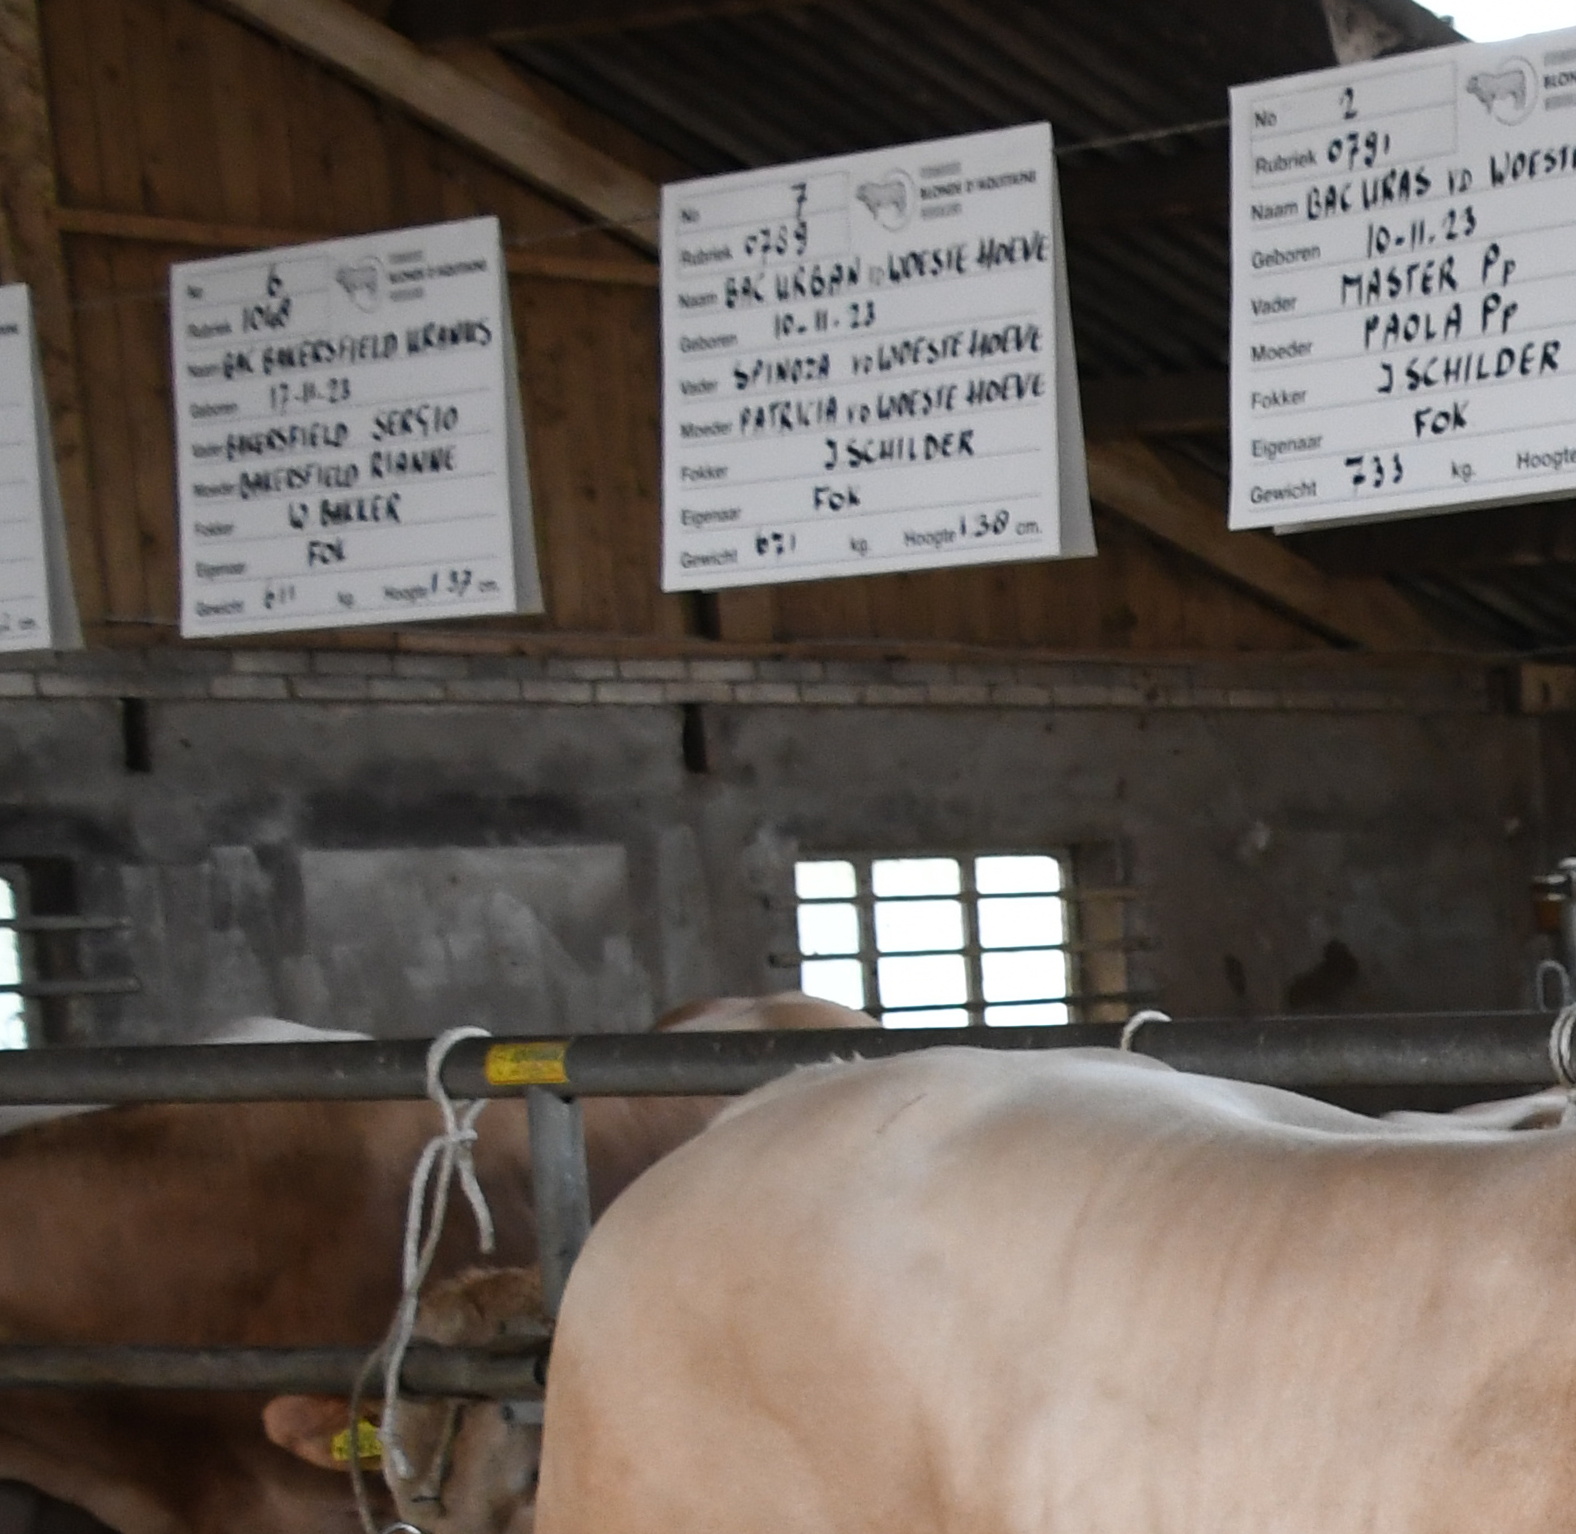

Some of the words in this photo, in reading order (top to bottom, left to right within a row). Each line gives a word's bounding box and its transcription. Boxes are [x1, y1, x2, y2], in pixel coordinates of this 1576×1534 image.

[1254, 110, 1277, 128] No
[1339, 86, 1358, 120] 2
[1254, 149, 1317, 175] Rubriek
[1251, 201, 1299, 220] Naam
[1306, 182, 1353, 221] BAC
[1362, 165, 1432, 211] URAS
[1252, 245, 1322, 269] Geboren
[1251, 296, 1298, 317] Vader
[1340, 255, 1459, 307] MASTER
[680, 331, 738, 353] Geboren
[1250, 339, 1314, 363] Moeder
[1364, 301, 1463, 351] PAOLA
[1251, 388, 1308, 410] Fokker
[1404, 339, 1562, 391] SCHILDER
[681, 465, 729, 482] Fokker
[846, 428, 975, 468] SCHILDER
[1251, 434, 1324, 459] Eigenaar
[1413, 400, 1470, 438] FOK
[813, 485, 861, 512] FOK
[1250, 480, 1318, 505] Gewicht
[1344, 453, 1403, 494] 733
[681, 549, 738, 569] Gewicht
[904, 527, 957, 550] Hoogte
